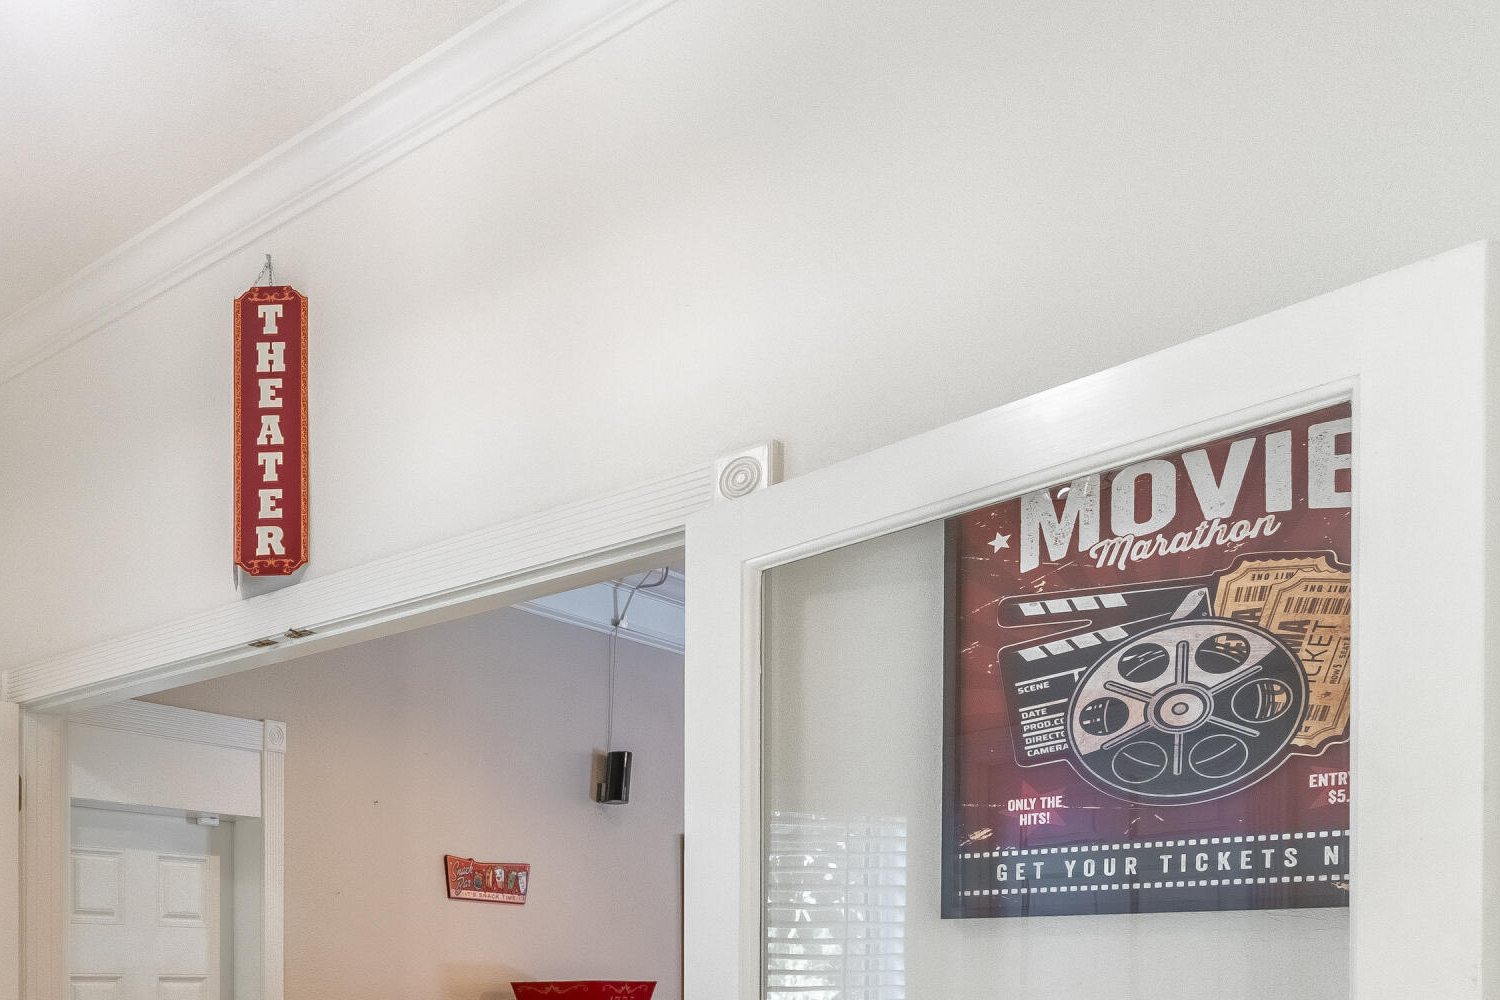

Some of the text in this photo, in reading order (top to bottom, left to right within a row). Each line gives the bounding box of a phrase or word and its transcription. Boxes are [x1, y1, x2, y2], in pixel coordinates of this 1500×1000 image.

[255, 304, 286, 556] THEATER
[1019, 417, 1351, 573] MOVIE
[1089, 511, 1281, 571] Marathon
[1017, 681, 1050, 695] SCENE
[1021, 708, 1048, 719] DATE
[1025, 731, 1065, 745] DIRECT
[1027, 743, 1069, 757] CAMERA
[1309, 771, 1350, 788] ENTR
[1007, 795, 1064, 811] ONLY THE
[1019, 812, 1051, 826] HITS!
[997, 861, 1045, 882] GET
[1065, 856, 1138, 879] YOUR
[1159, 847, 1298, 874] TICKETS
